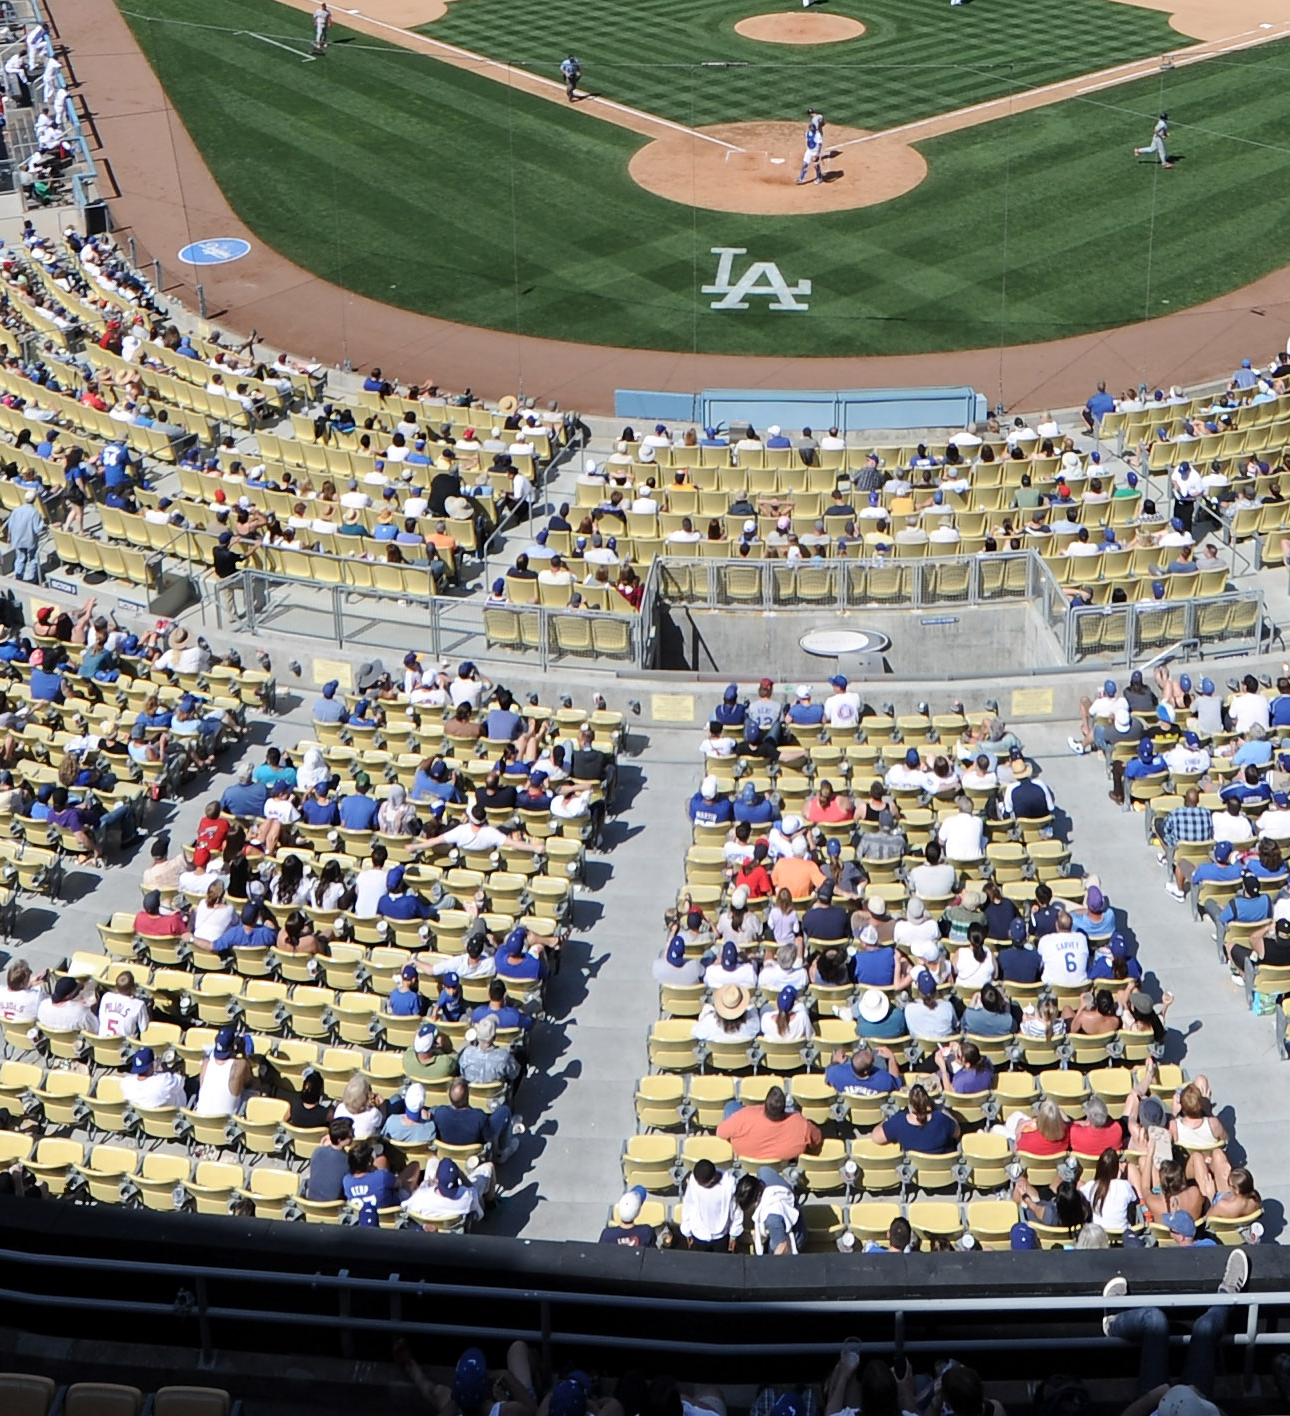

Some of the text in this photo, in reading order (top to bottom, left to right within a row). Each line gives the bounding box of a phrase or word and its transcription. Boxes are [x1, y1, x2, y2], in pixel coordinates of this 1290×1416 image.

[701, 247, 812, 311] LA
[757, 716, 773, 727] 12
[1055, 941, 1080, 951] GARVEY
[1064, 951, 1078, 973] 6
[104, 1001, 131, 1018] PUJOLS
[107, 1018, 119, 1035] 5
